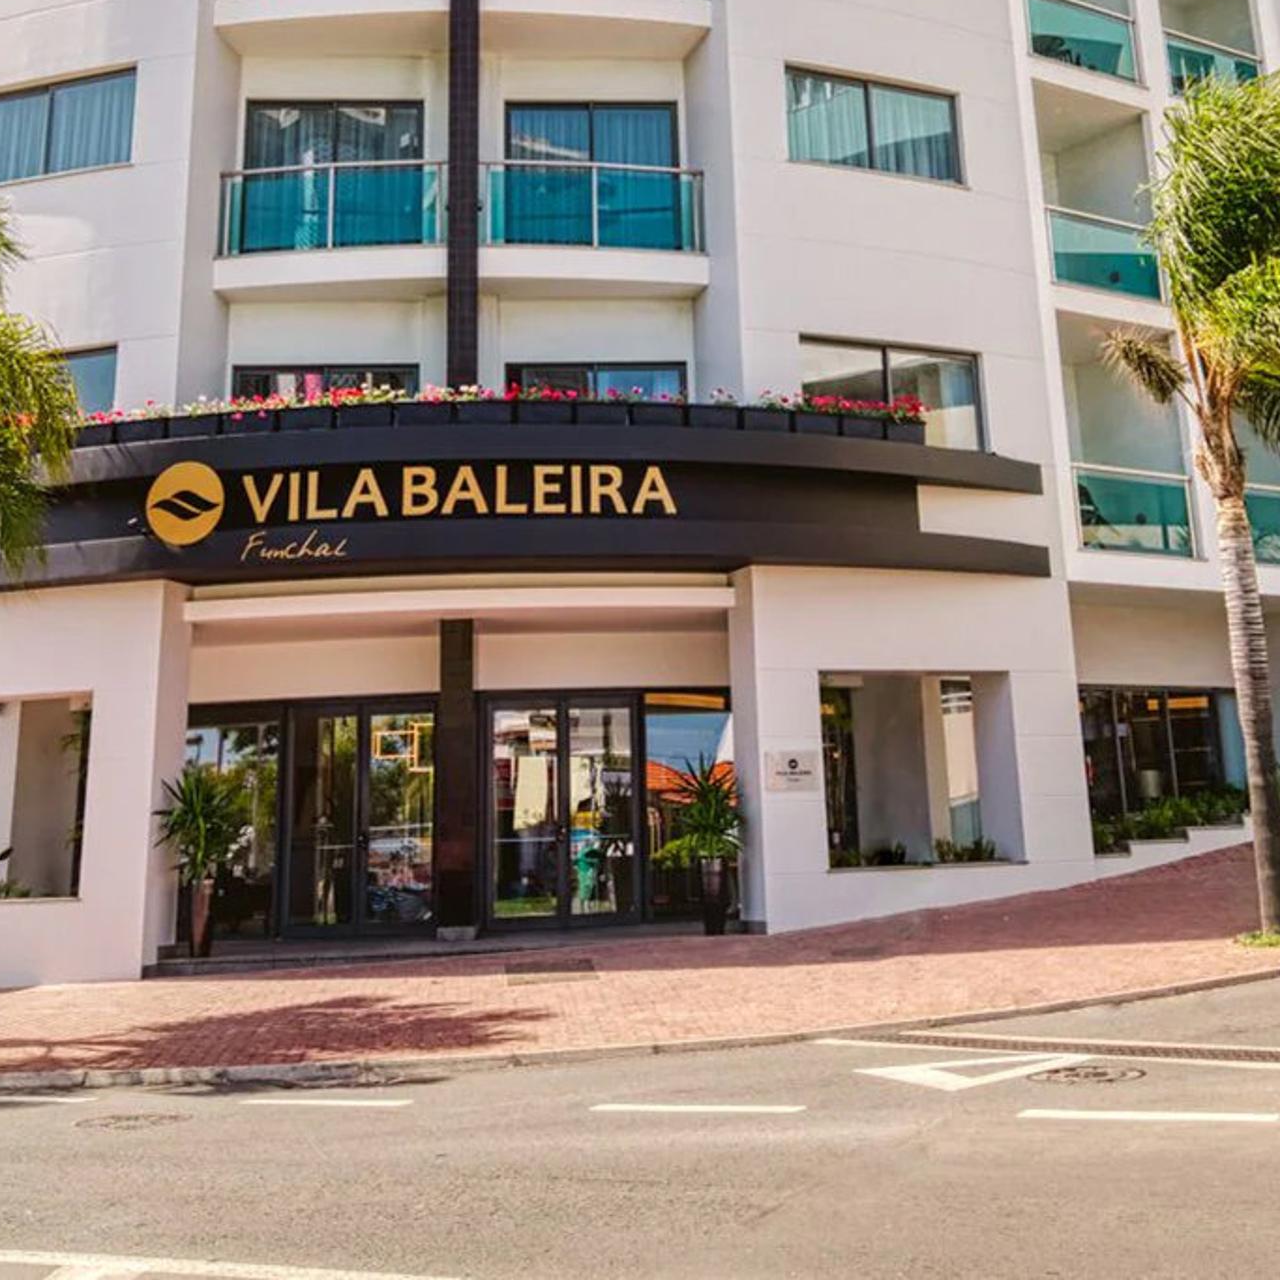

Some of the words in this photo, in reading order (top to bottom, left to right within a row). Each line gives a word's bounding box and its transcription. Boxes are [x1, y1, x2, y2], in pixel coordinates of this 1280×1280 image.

[242, 469, 389, 523] VILA
[401, 464, 678, 516] BALEIRA
[240, 525, 348, 562] Funchal
